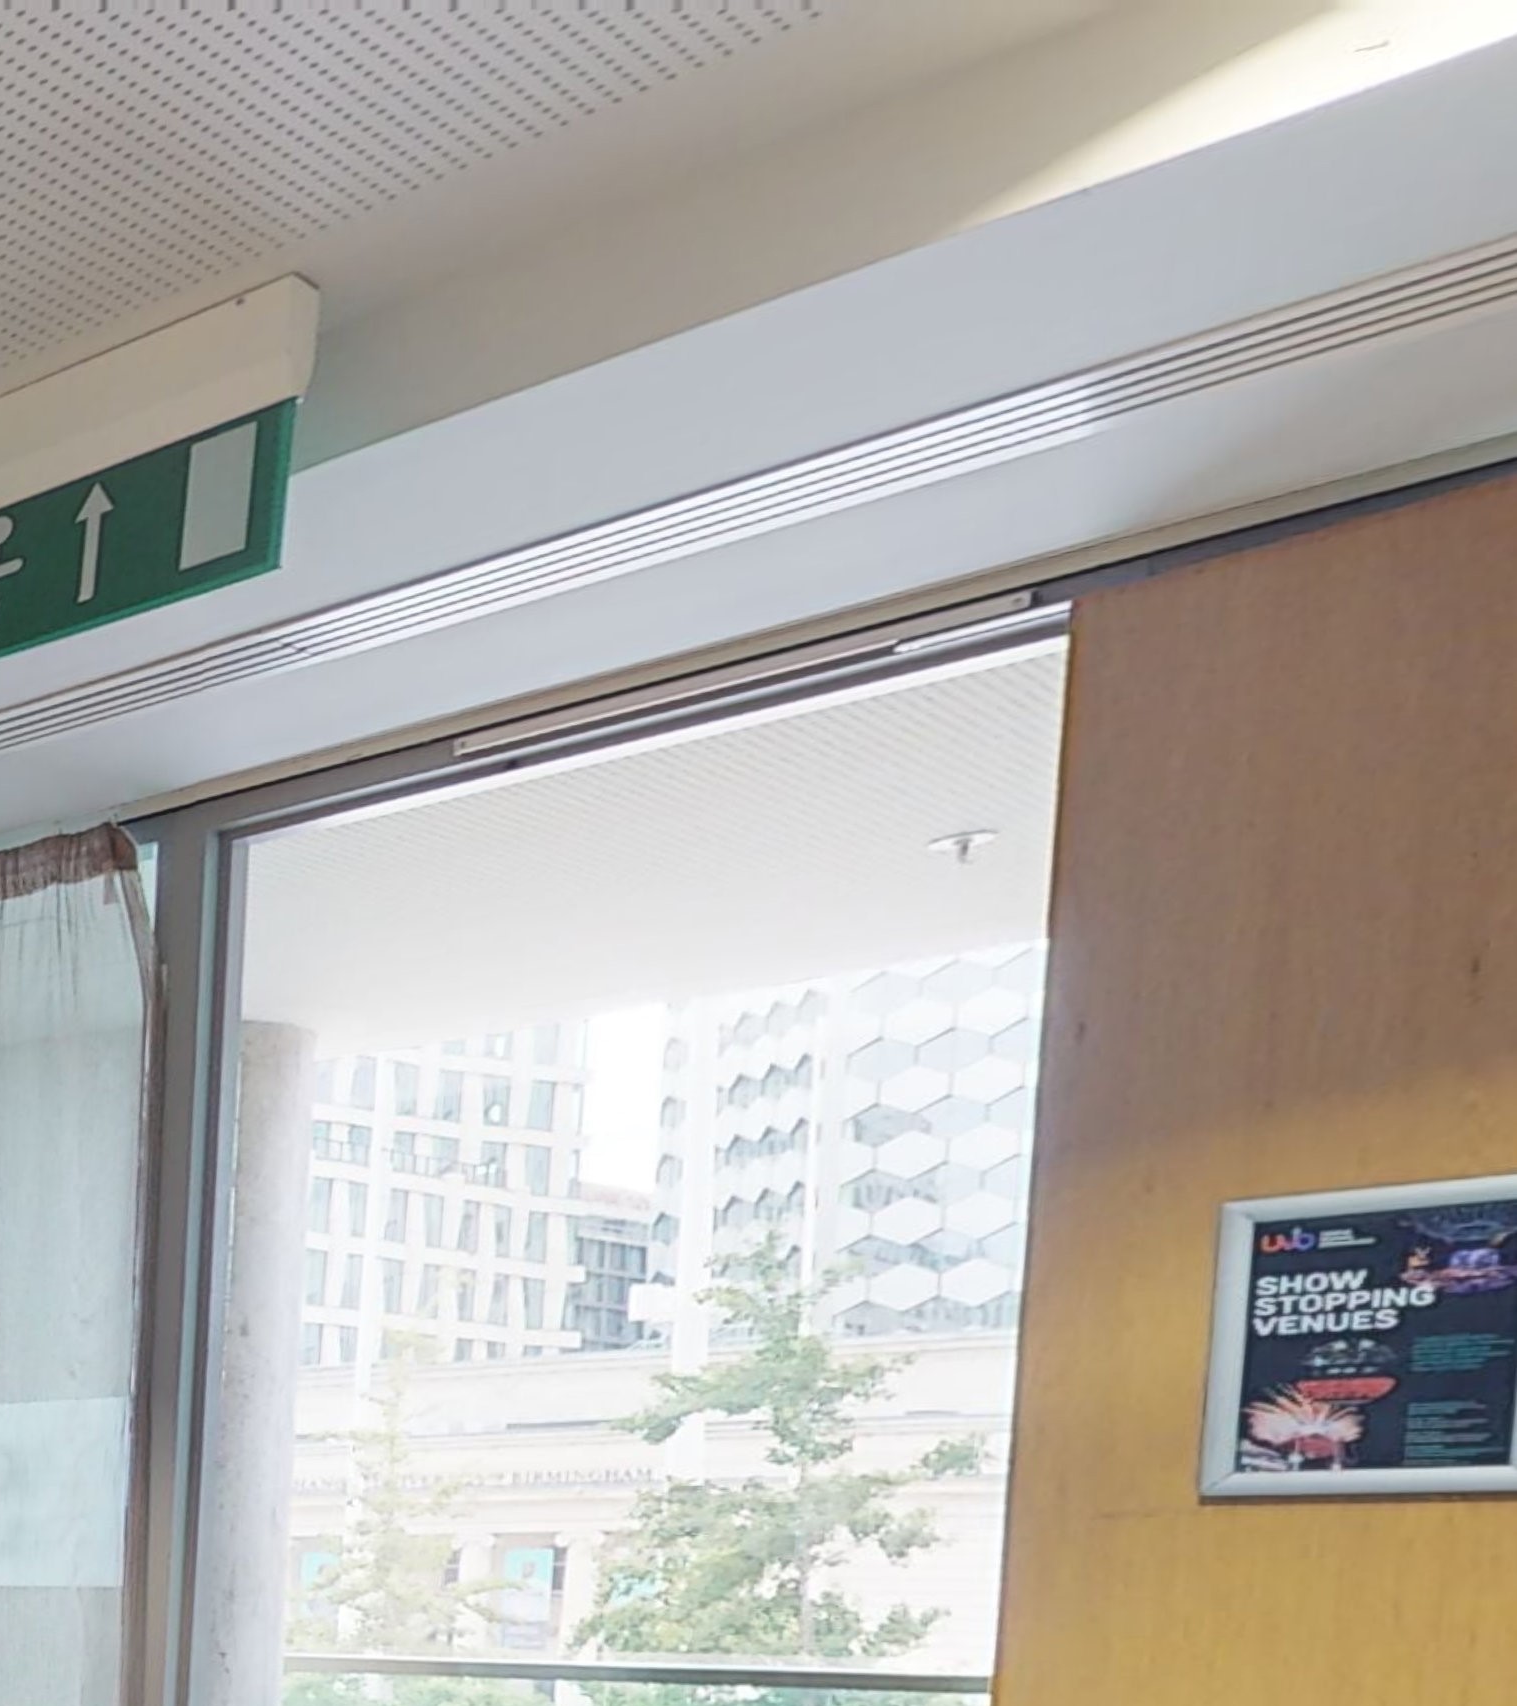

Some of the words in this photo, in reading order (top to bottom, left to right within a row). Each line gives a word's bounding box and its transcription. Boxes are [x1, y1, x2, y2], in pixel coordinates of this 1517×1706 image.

[1256, 1268, 1368, 1296] SHOW
[1253, 1284, 1437, 1317] STOPPING
[1252, 1308, 1400, 1337] VENUES
